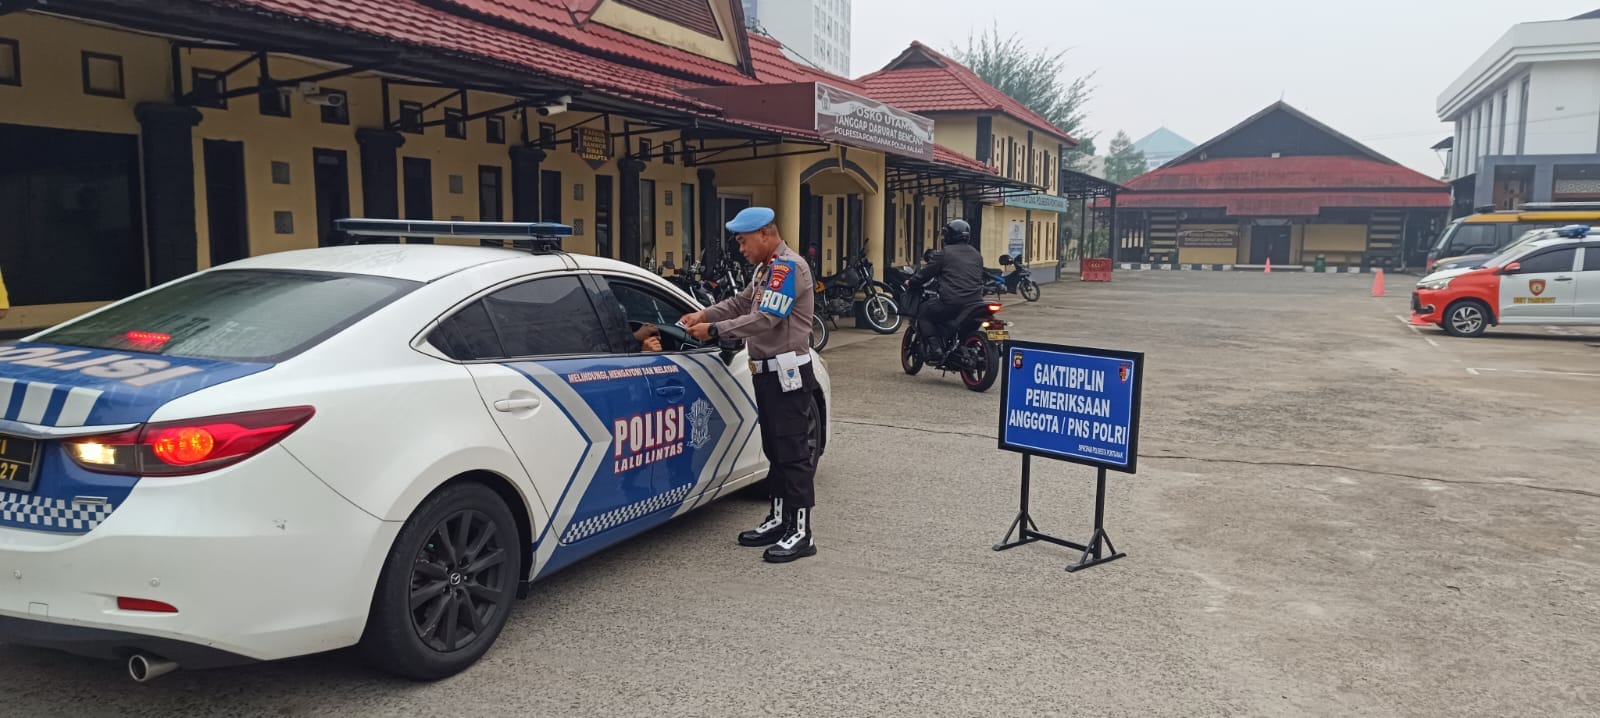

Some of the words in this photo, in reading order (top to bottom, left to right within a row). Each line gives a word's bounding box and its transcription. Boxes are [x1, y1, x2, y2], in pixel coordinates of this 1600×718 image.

[835, 114, 867, 131] TANGGAP
[868, 122, 897, 139] DARURAT
[898, 131, 924, 147] BENCANA
[849, 102, 882, 122] POSKO
[884, 114, 913, 132] UTAMA
[834, 126, 863, 139] POLRESTA
[863, 131, 891, 146] PONTIANAK
[642, 366, 654, 376] DAN
[1034, 362, 1105, 393] GAKTIBPLIN
[1025, 388, 1111, 418] PEMERIKSAAN
[613, 405, 684, 458] POLISI
[1009, 409, 1059, 434] ANGGOTA
[1061, 416, 1066, 435] /
[1067, 417, 1090, 439] PNS
[1092, 422, 1127, 445] POLRI
[614, 453, 643, 475] LALU
[645, 442, 684, 465] LINTAS
